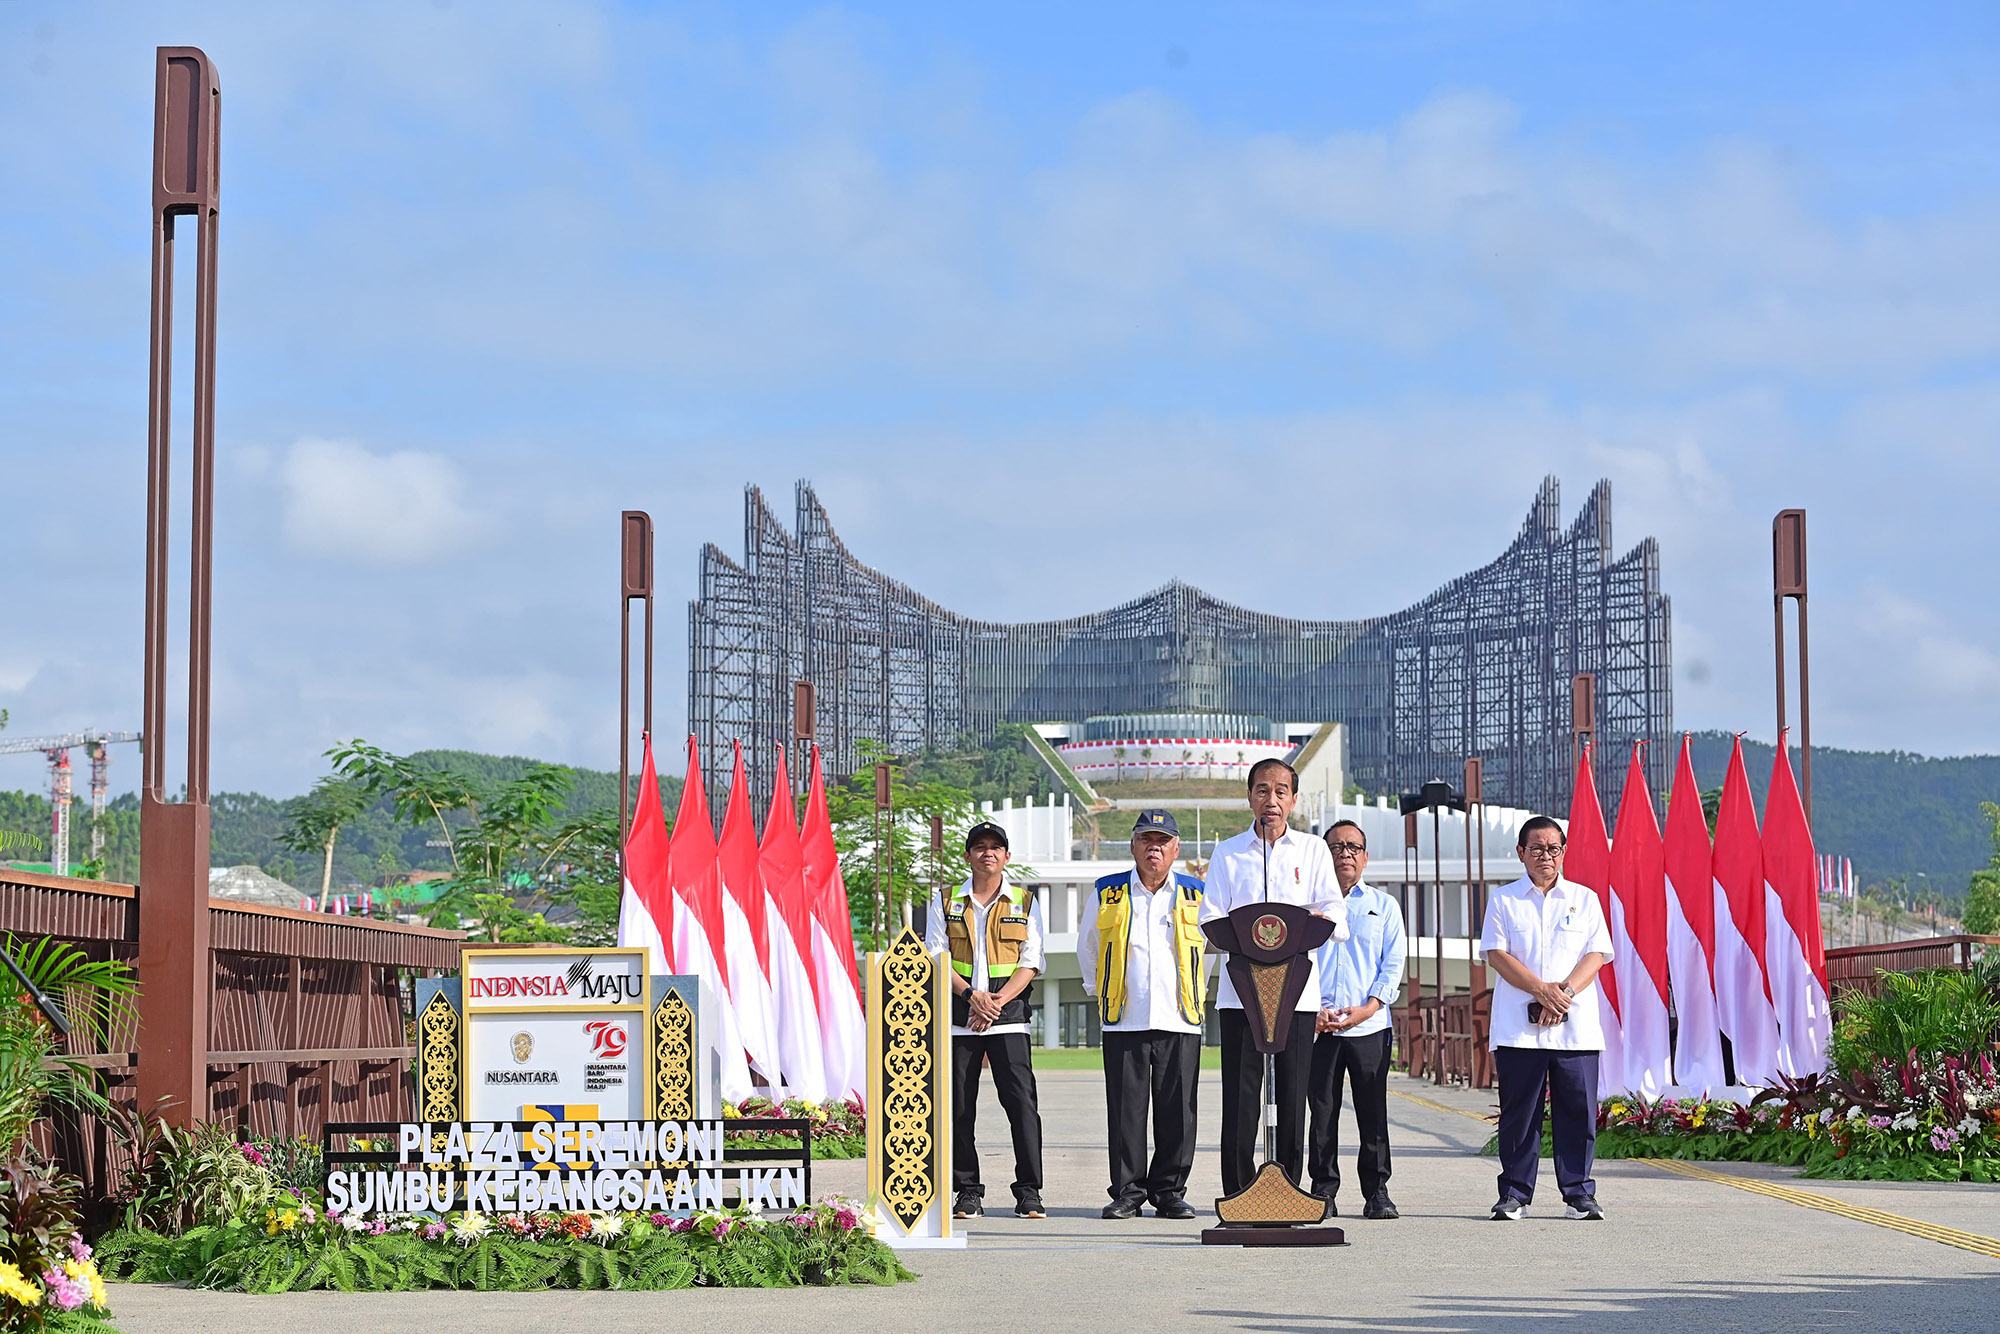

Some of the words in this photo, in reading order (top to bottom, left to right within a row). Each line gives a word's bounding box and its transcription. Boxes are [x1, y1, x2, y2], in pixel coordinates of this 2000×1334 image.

[580, 975, 643, 1004] MAJU
[586, 1021, 627, 1058] 79
[487, 1072, 559, 1083] NUSANTARA
[400, 1122, 520, 1164] PLAZA
[530, 1120, 724, 1163] SEREMONI
[326, 1171, 455, 1213] SUMBU
[467, 1168, 722, 1212] KEBANGSAAN
[740, 1168, 805, 1210] IKN
